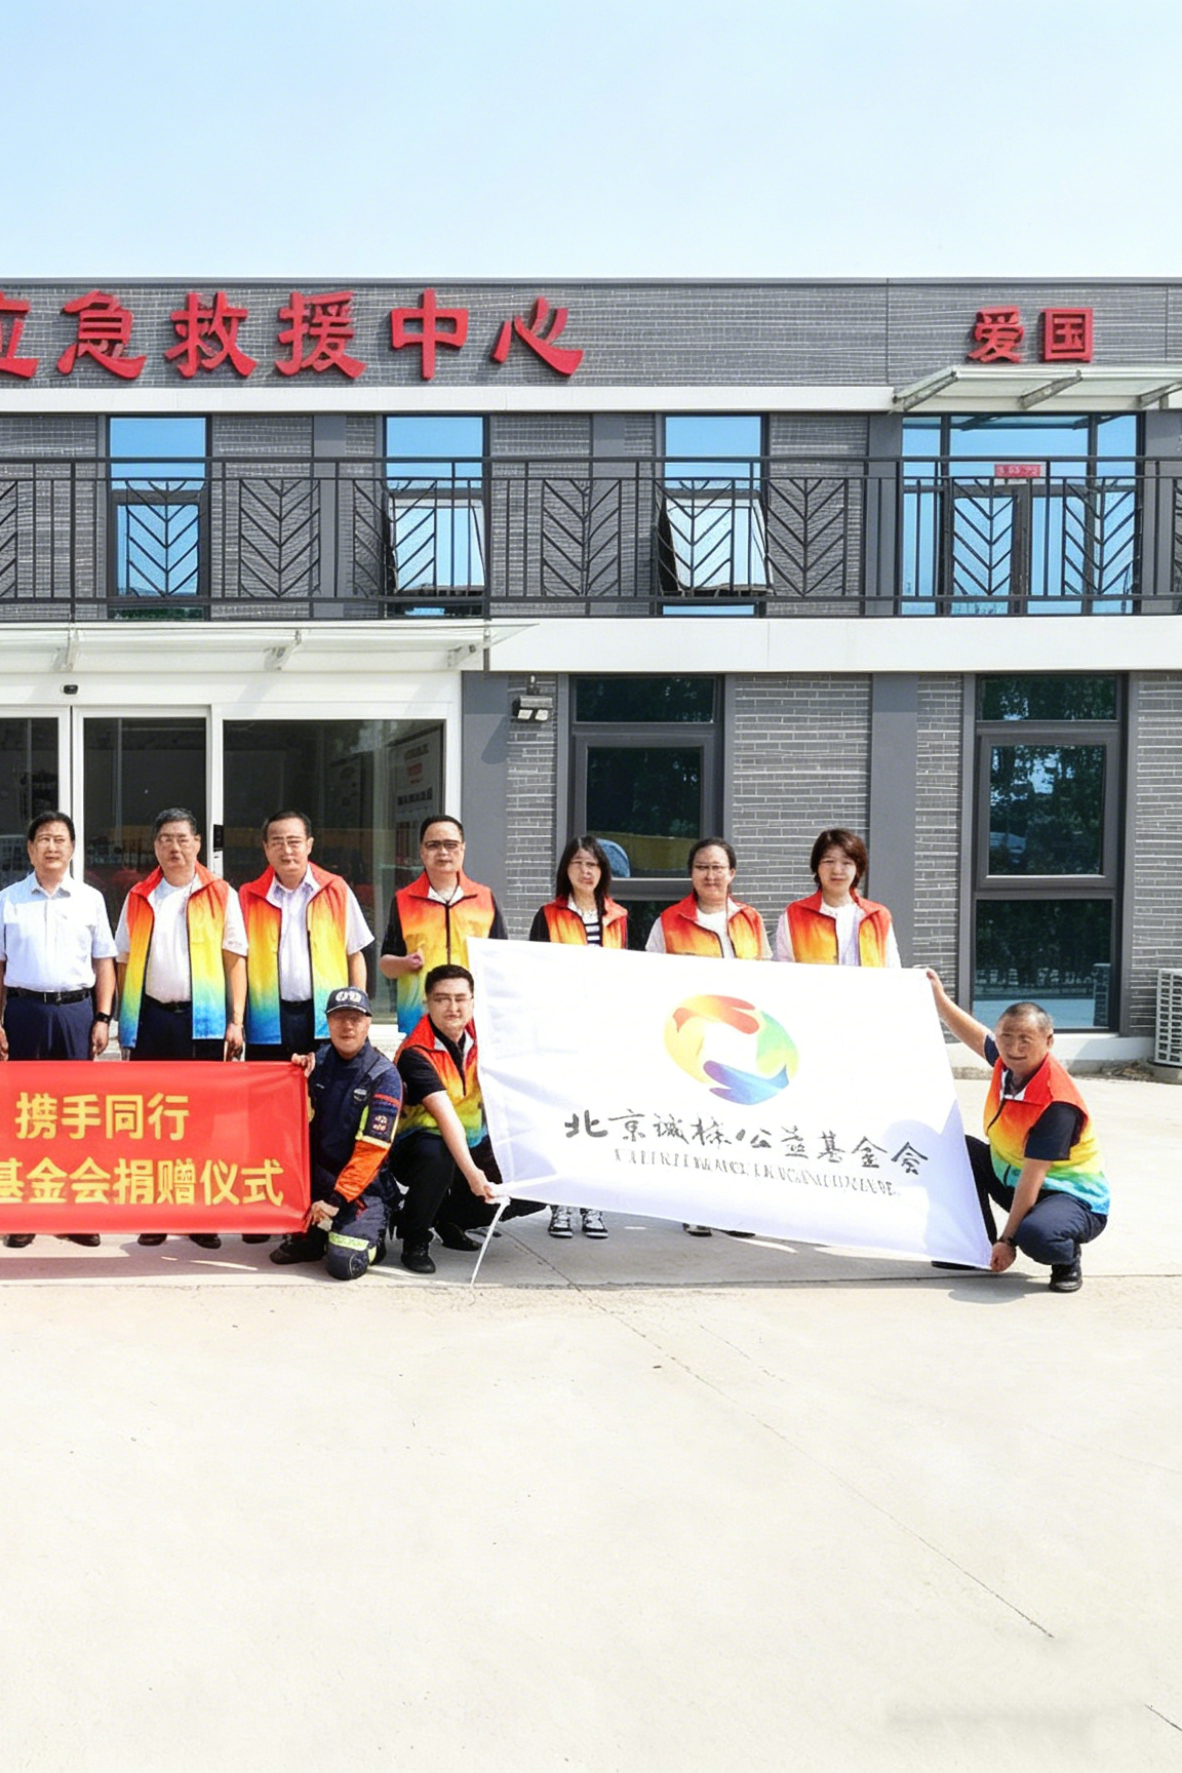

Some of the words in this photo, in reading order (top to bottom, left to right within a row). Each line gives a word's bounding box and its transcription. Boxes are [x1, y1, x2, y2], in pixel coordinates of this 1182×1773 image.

[968, 306, 1093, 363] 爱国
[15, 1092, 189, 1140] 携手同行
